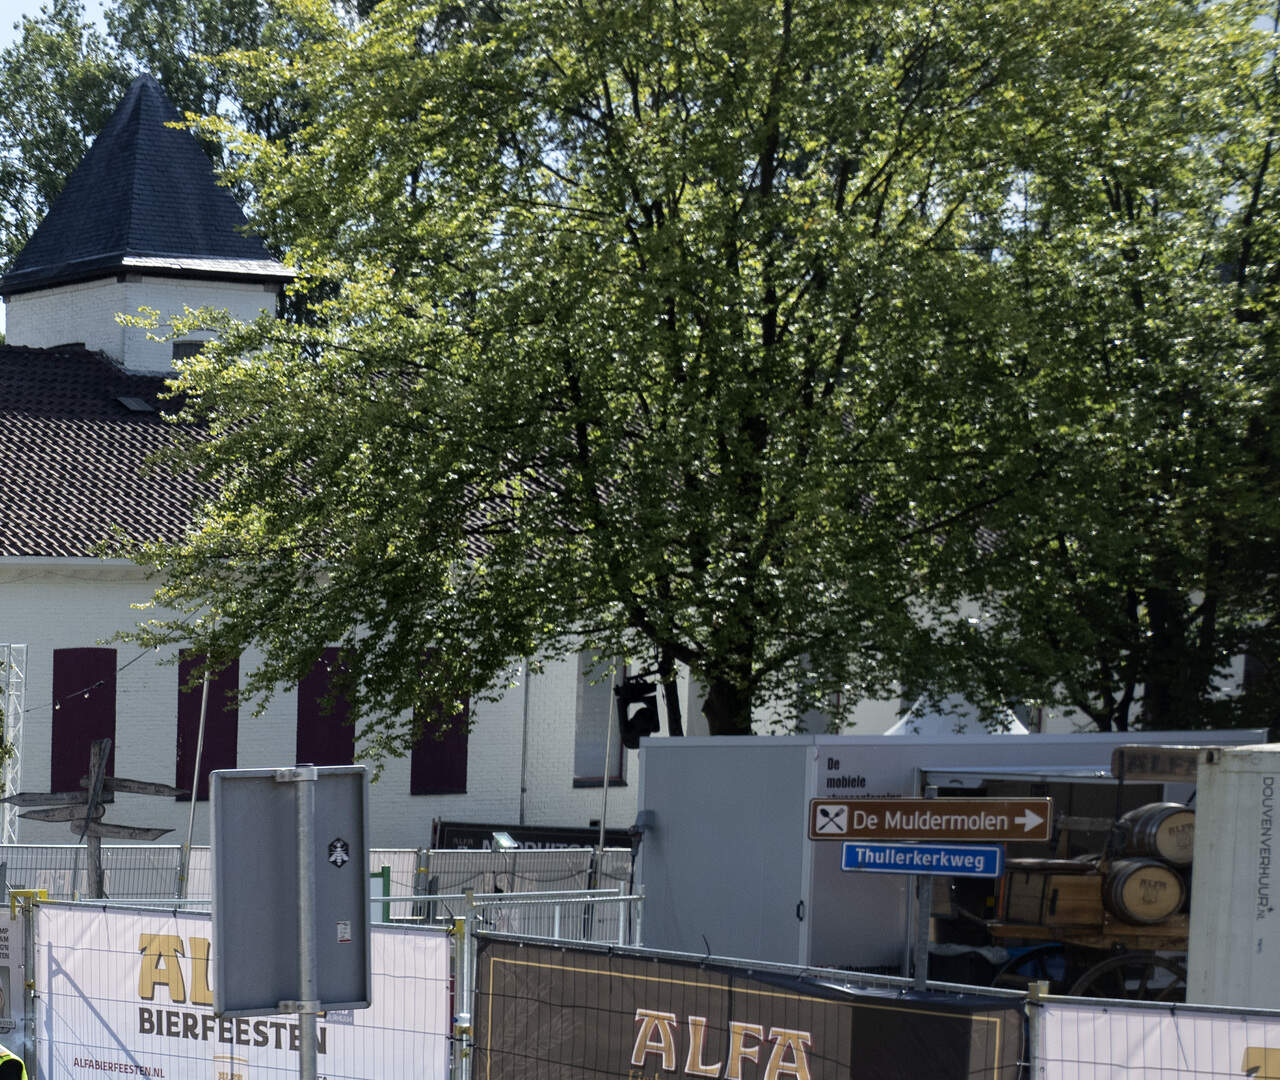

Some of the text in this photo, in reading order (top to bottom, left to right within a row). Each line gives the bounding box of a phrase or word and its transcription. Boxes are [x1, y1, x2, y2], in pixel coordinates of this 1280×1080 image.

[827, 757, 841, 771] De
[826, 775, 866, 789] mobiele
[853, 810, 1008, 831] De Muldermolen
[855, 847, 985, 872] Thullerkerkweg
[138, 933, 215, 1007] AL
[73, 1056, 166, 1080] ALFABIERFEESTEN.NL
